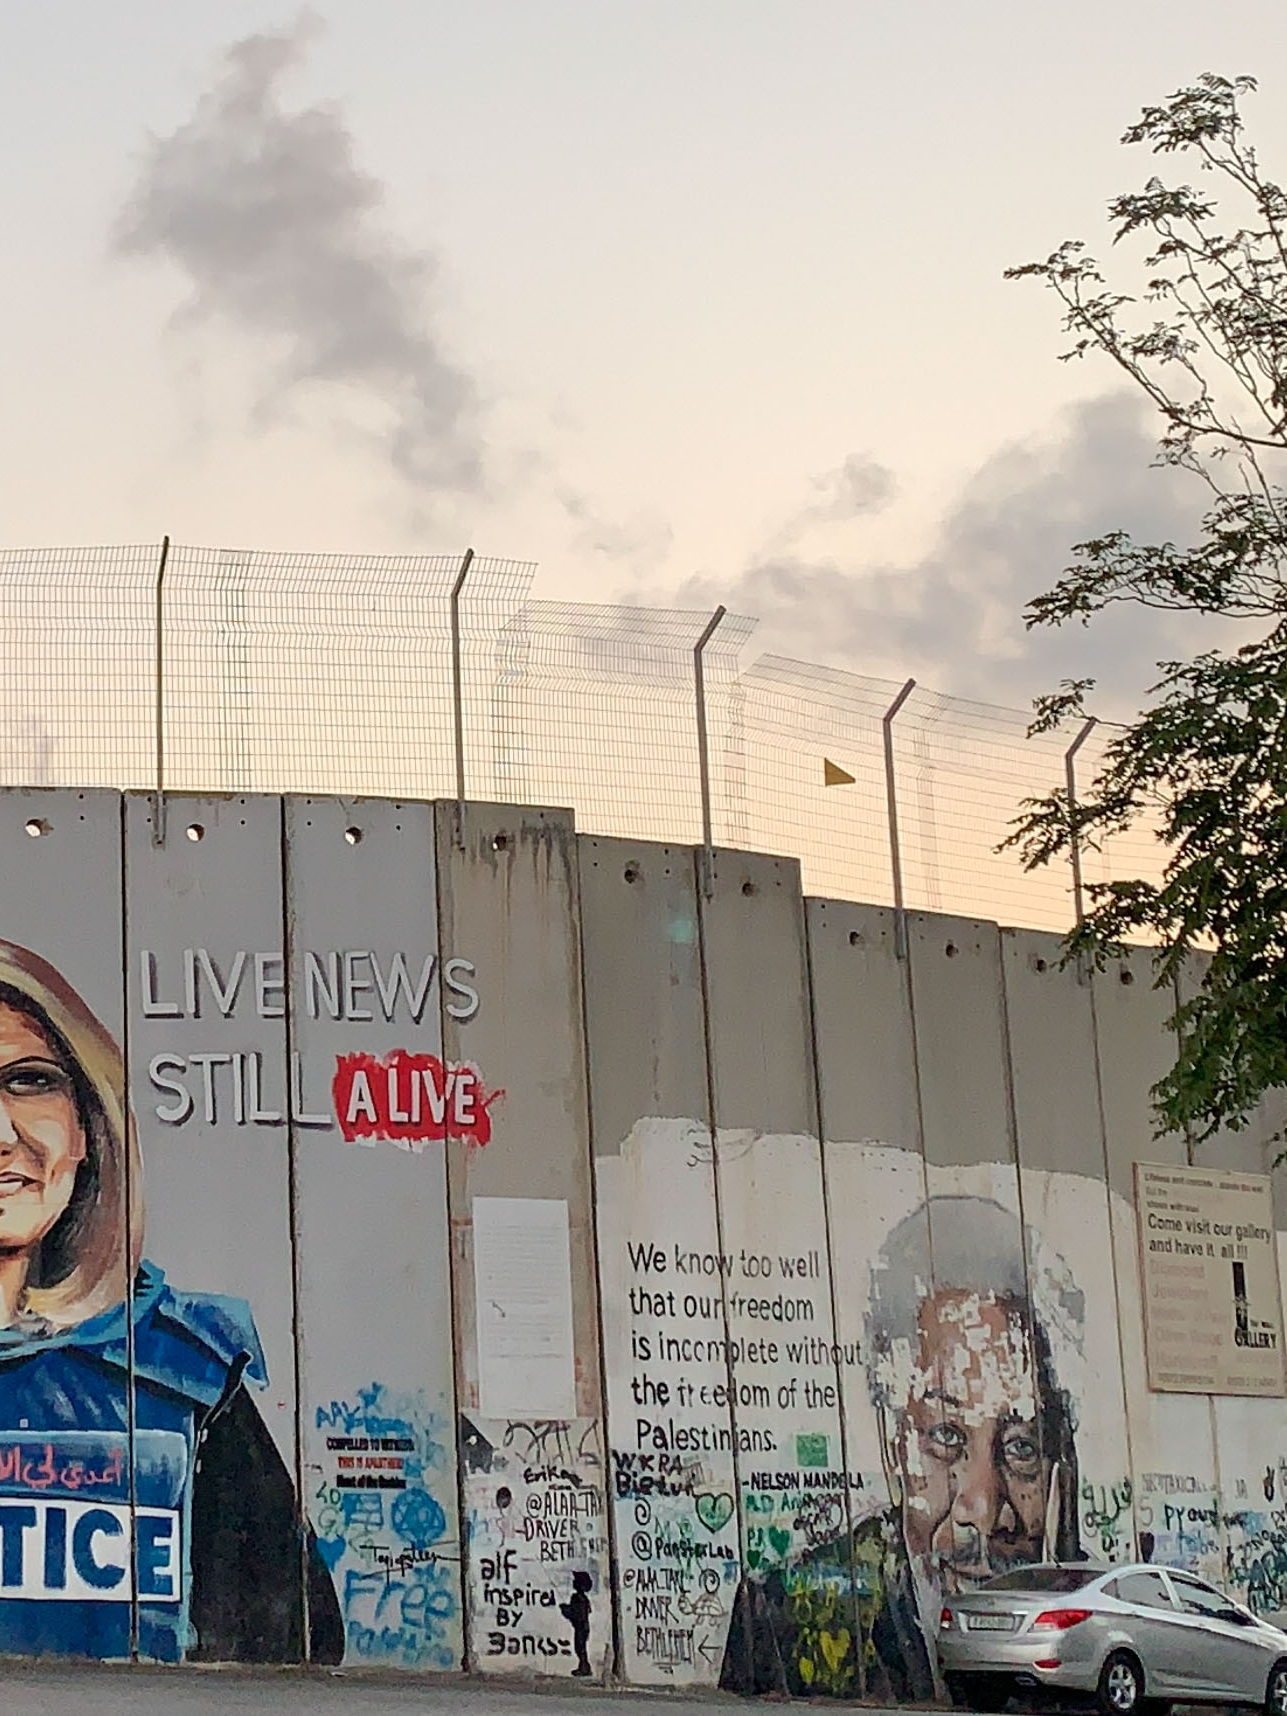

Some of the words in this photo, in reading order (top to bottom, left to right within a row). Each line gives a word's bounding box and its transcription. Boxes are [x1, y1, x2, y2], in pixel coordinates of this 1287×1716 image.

[140, 948, 285, 1020] LIVE
[305, 950, 480, 1024] NEWS
[148, 1052, 334, 1129] STILL
[1148, 1213, 1183, 1232] Come
[1185, 1219, 1211, 1235] visit
[1214, 1223, 1233, 1236] our
[1235, 1224, 1271, 1245] gallery
[628, 1242, 667, 1273] We
[675, 1244, 734, 1278] know
[740, 1249, 772, 1278] too
[778, 1251, 819, 1279] well
[1149, 1239, 1173, 1253] and
[1174, 1239, 1203, 1256] have
[629, 1286, 677, 1317] that
[683, 1294, 723, 1319] our
[730, 1291, 815, 1322] freedom
[631, 1331, 652, 1361] is
[659, 1332, 779, 1371] incomplete
[786, 1336, 863, 1366] without
[1234, 1327, 1277, 1348] GALLERY
[631, 1373, 669, 1408] the
[777, 1379, 798, 1410] of
[804, 1379, 836, 1408] the
[636, 1419, 778, 1451] Palestinians.
[804, 1472, 864, 1490] MANDELA
